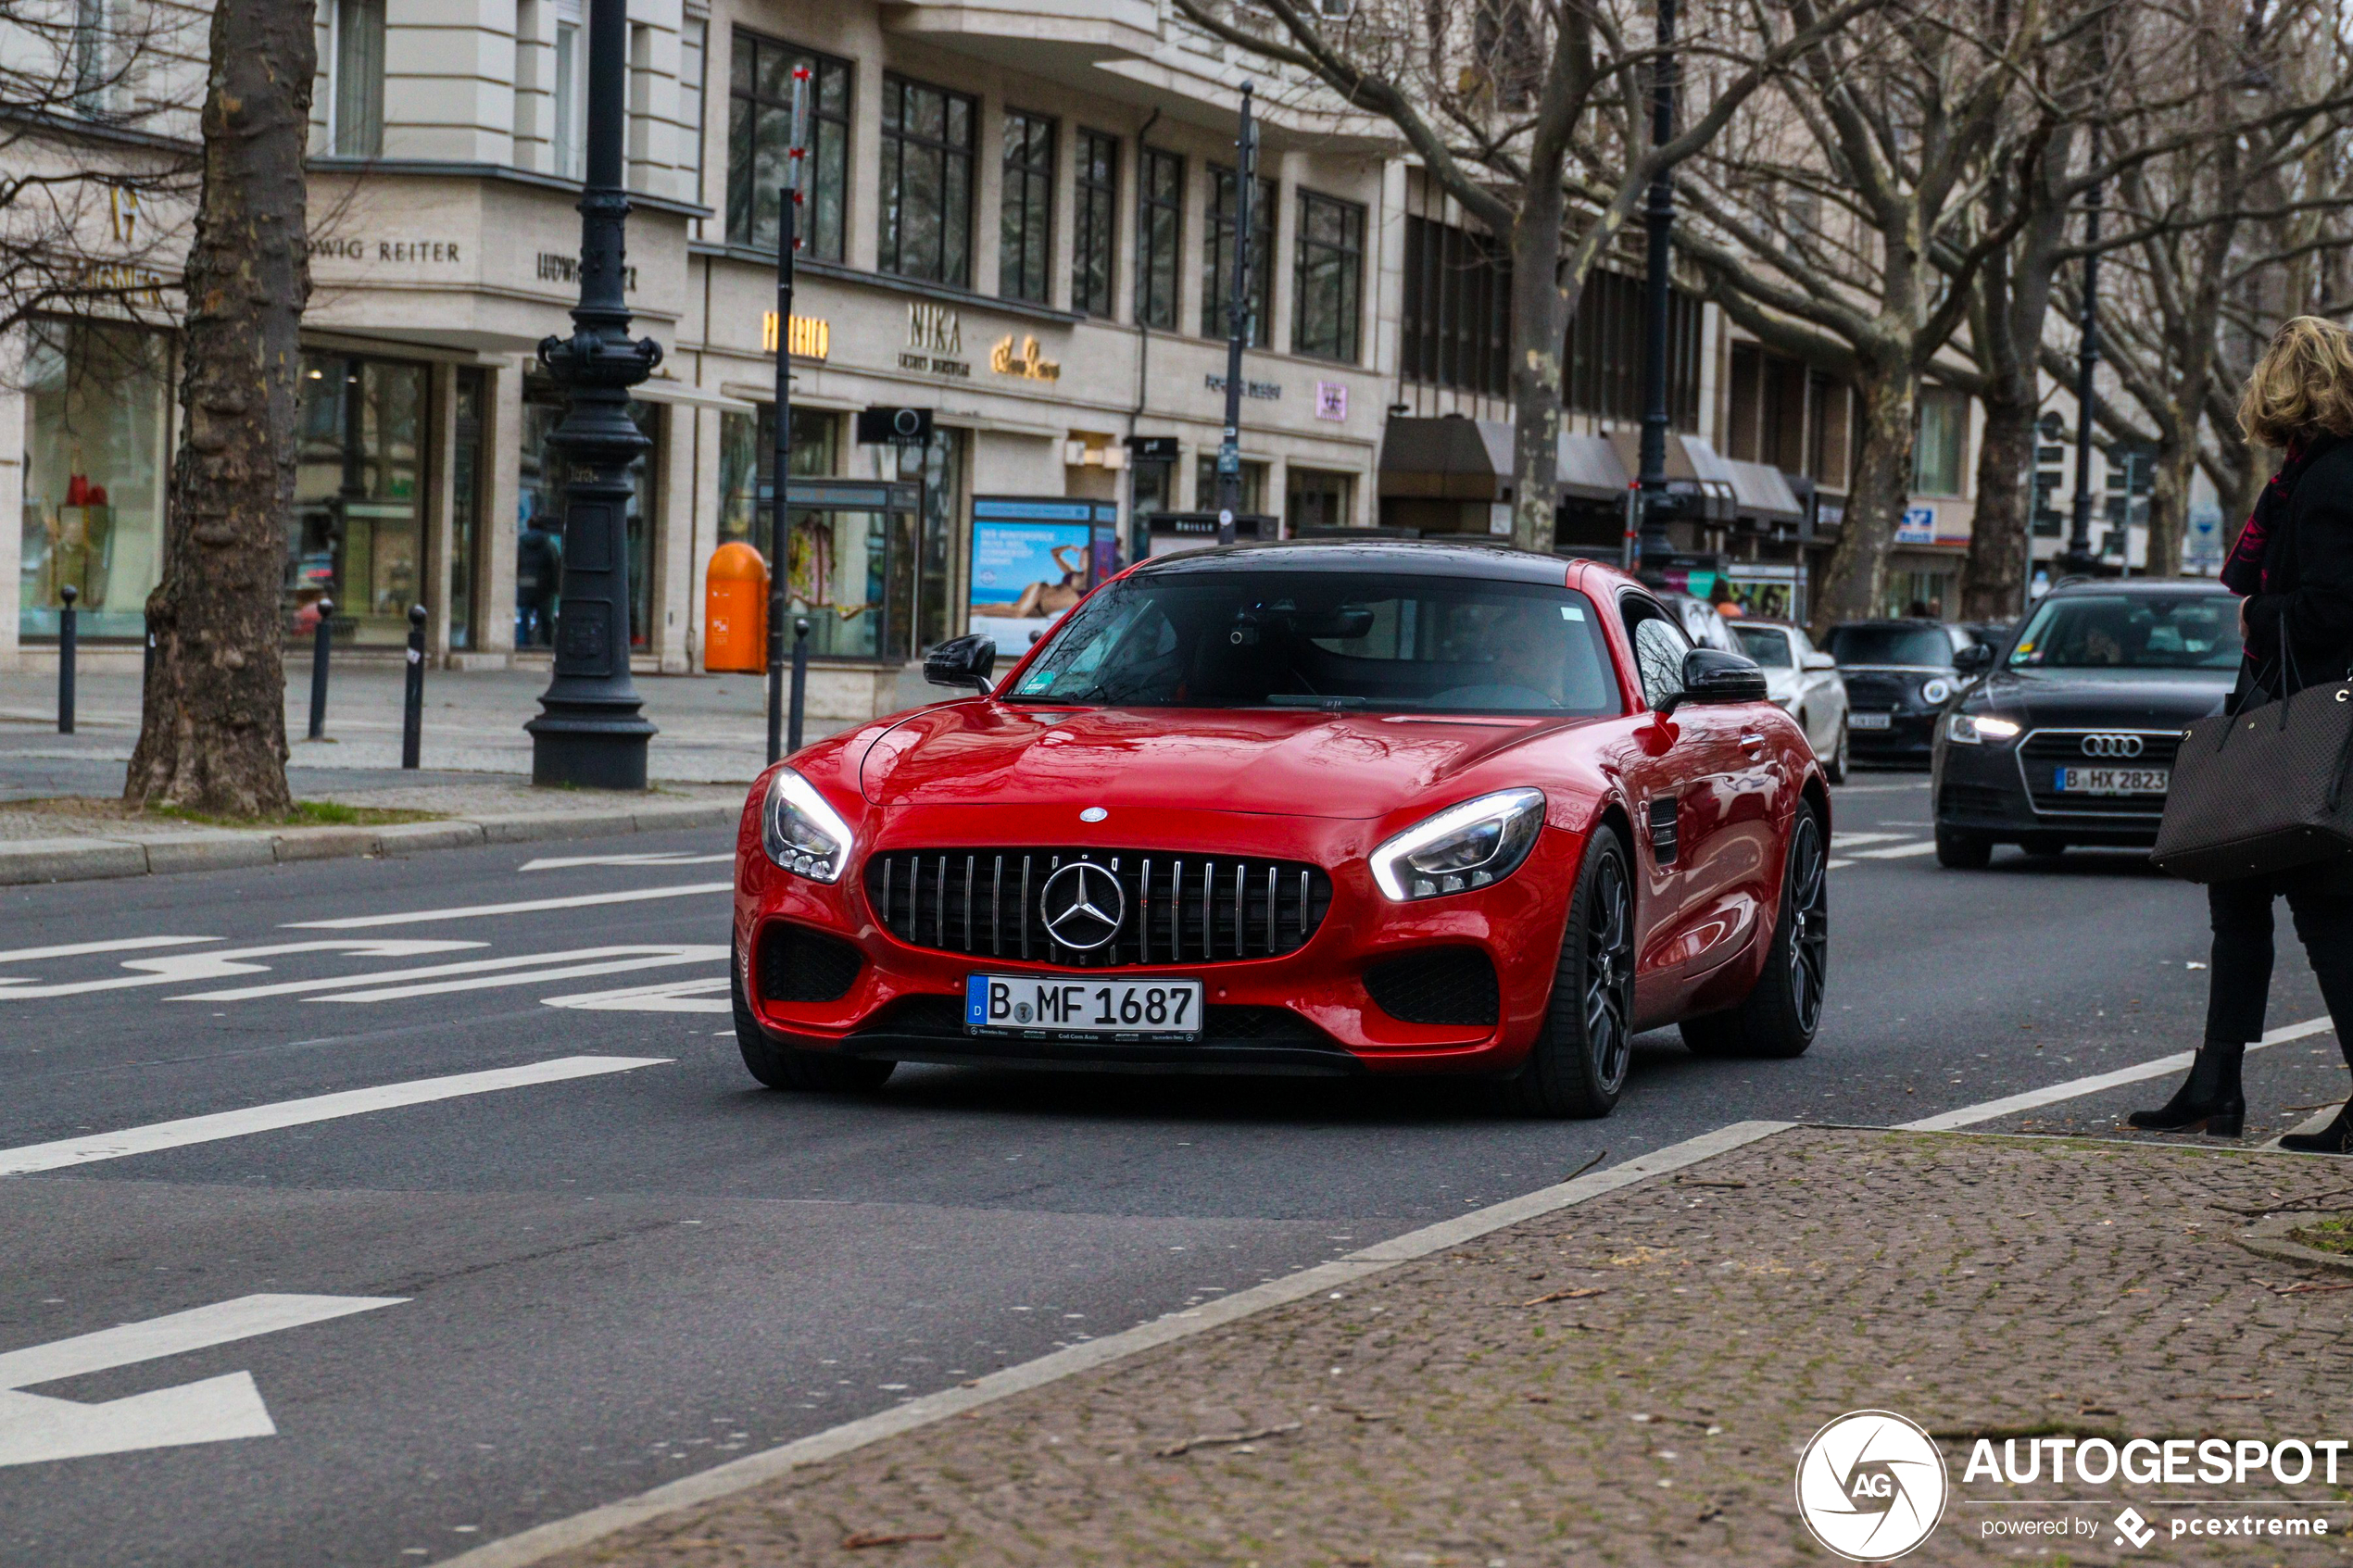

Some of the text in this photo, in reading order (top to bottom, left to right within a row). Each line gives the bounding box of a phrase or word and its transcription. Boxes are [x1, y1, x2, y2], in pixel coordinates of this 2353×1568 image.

[379, 241, 459, 262] REITER
[907, 302, 962, 355] NIKA
[2066, 771, 2165, 789] B HX 2823
[974, 1005, 982, 1016] D
[989, 983, 1192, 1024] B MF 1687
